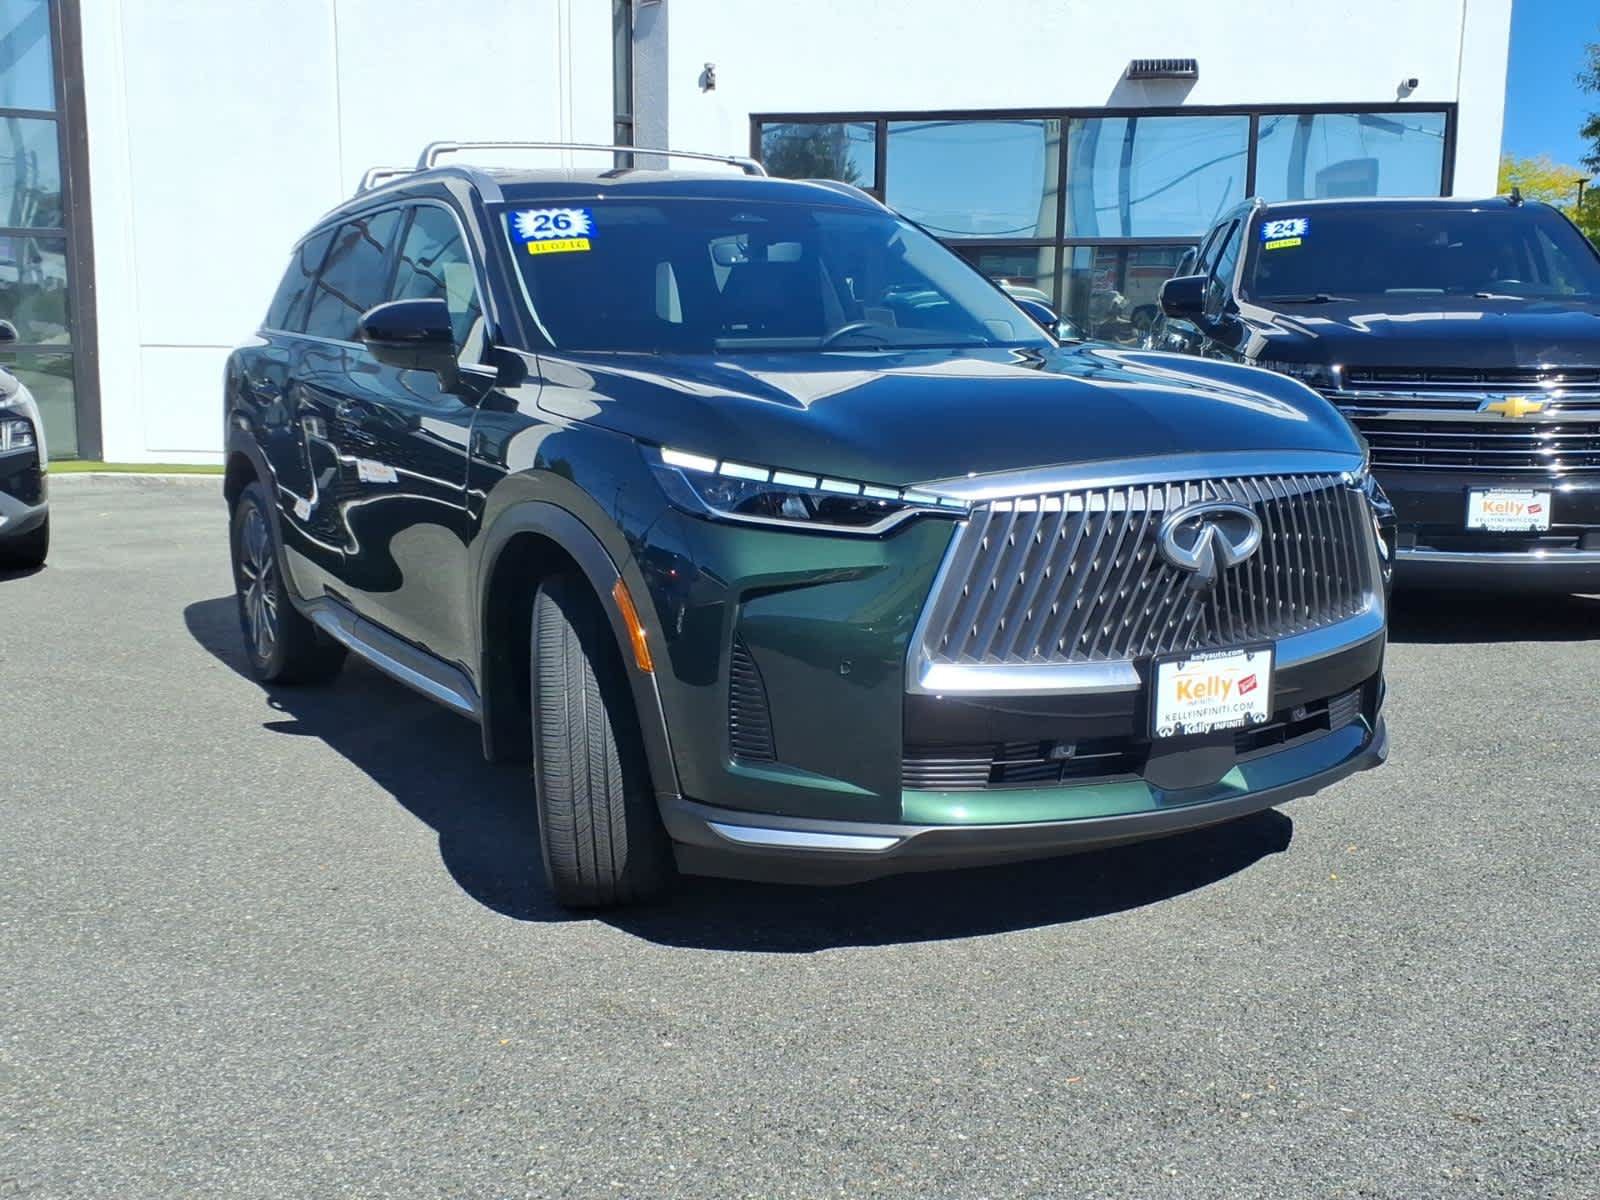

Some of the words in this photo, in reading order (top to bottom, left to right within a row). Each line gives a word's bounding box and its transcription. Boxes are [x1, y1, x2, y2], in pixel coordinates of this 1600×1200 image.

[533, 213, 572, 232] 26
[1273, 222, 1296, 234] 24
[1483, 501, 1523, 515] Kelly
[1191, 649, 1244, 661] kellyauto.com
[1176, 674, 1233, 703] Kelly
[1165, 702, 1254, 721] KELLYINFINITI.COM
[1184, 720, 1212, 735] Kelly
[1214, 719, 1245, 731] INFINITI
